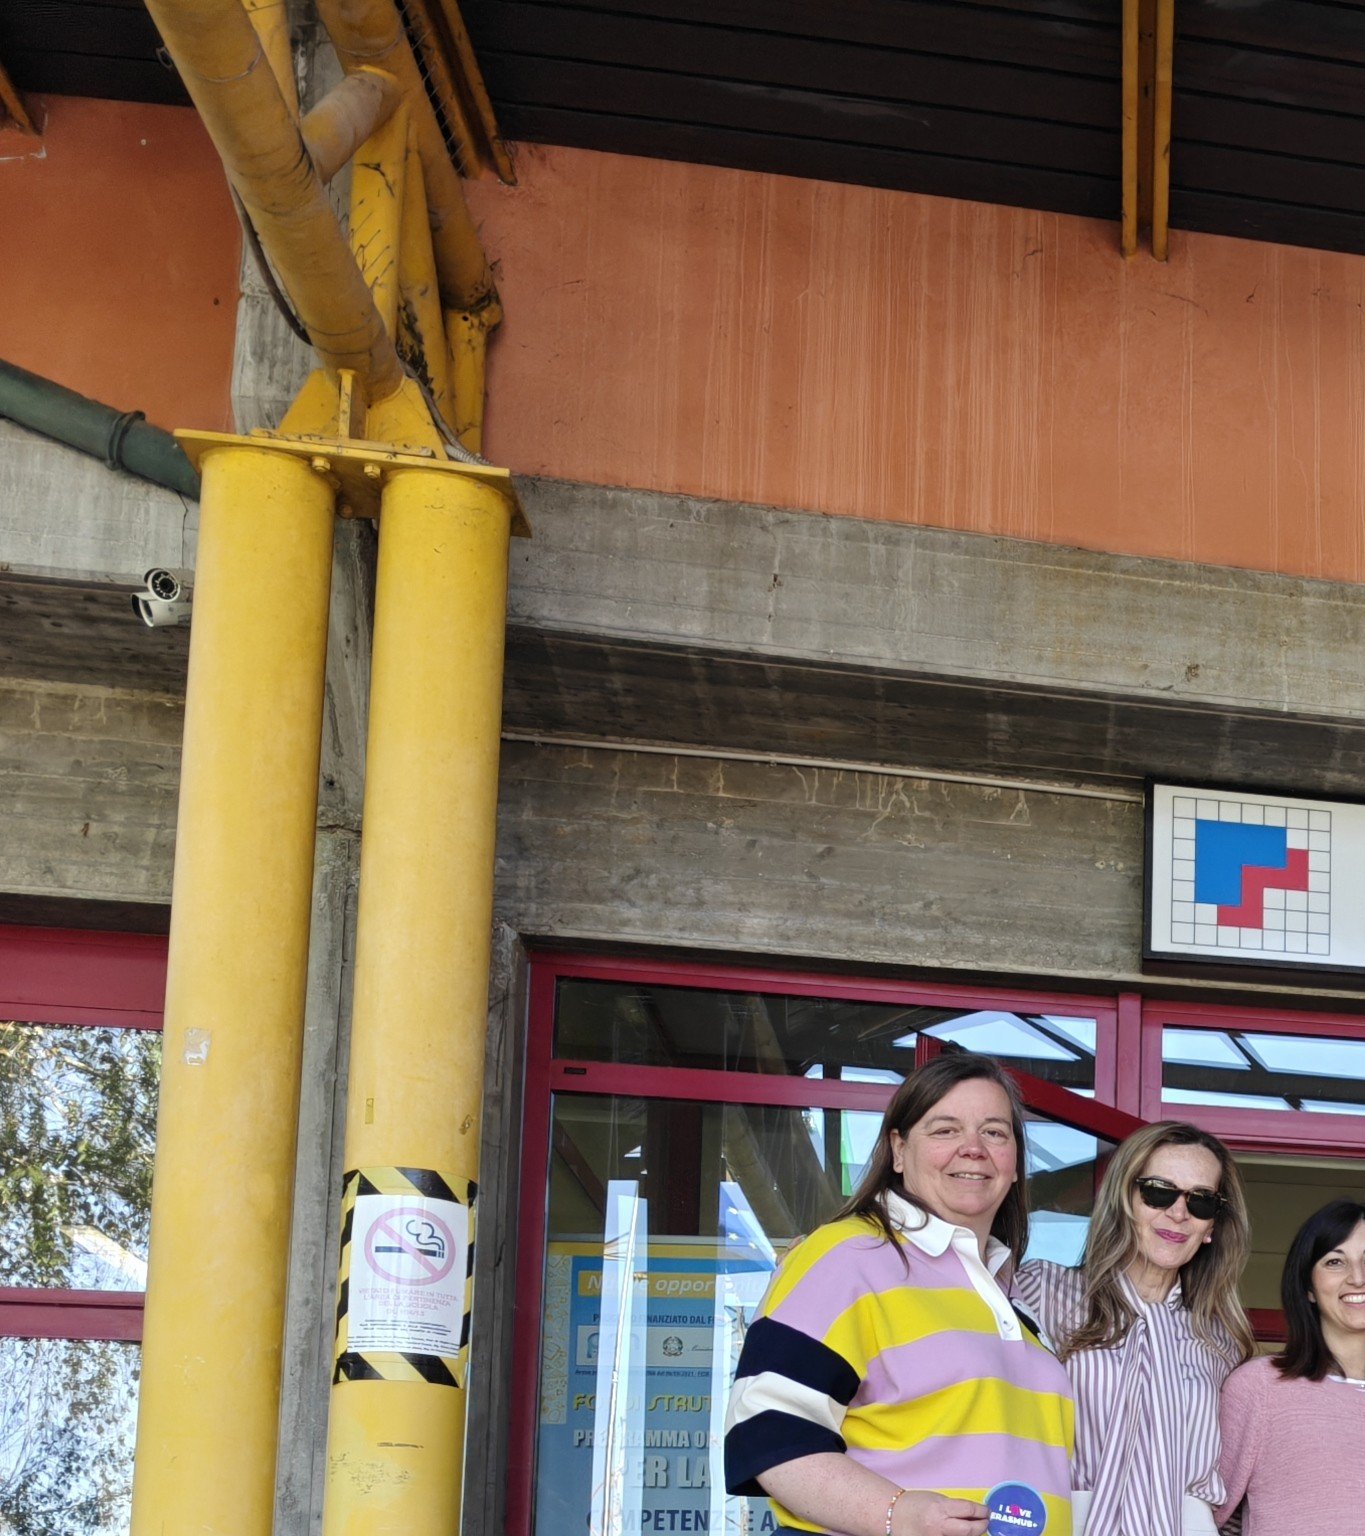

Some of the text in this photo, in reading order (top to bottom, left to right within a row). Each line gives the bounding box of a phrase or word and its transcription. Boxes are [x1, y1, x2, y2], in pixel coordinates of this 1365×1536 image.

[689, 1315, 706, 1326] DAL
[648, 1393, 712, 1413] STRUT
[998, 1504, 1003, 1512] I
